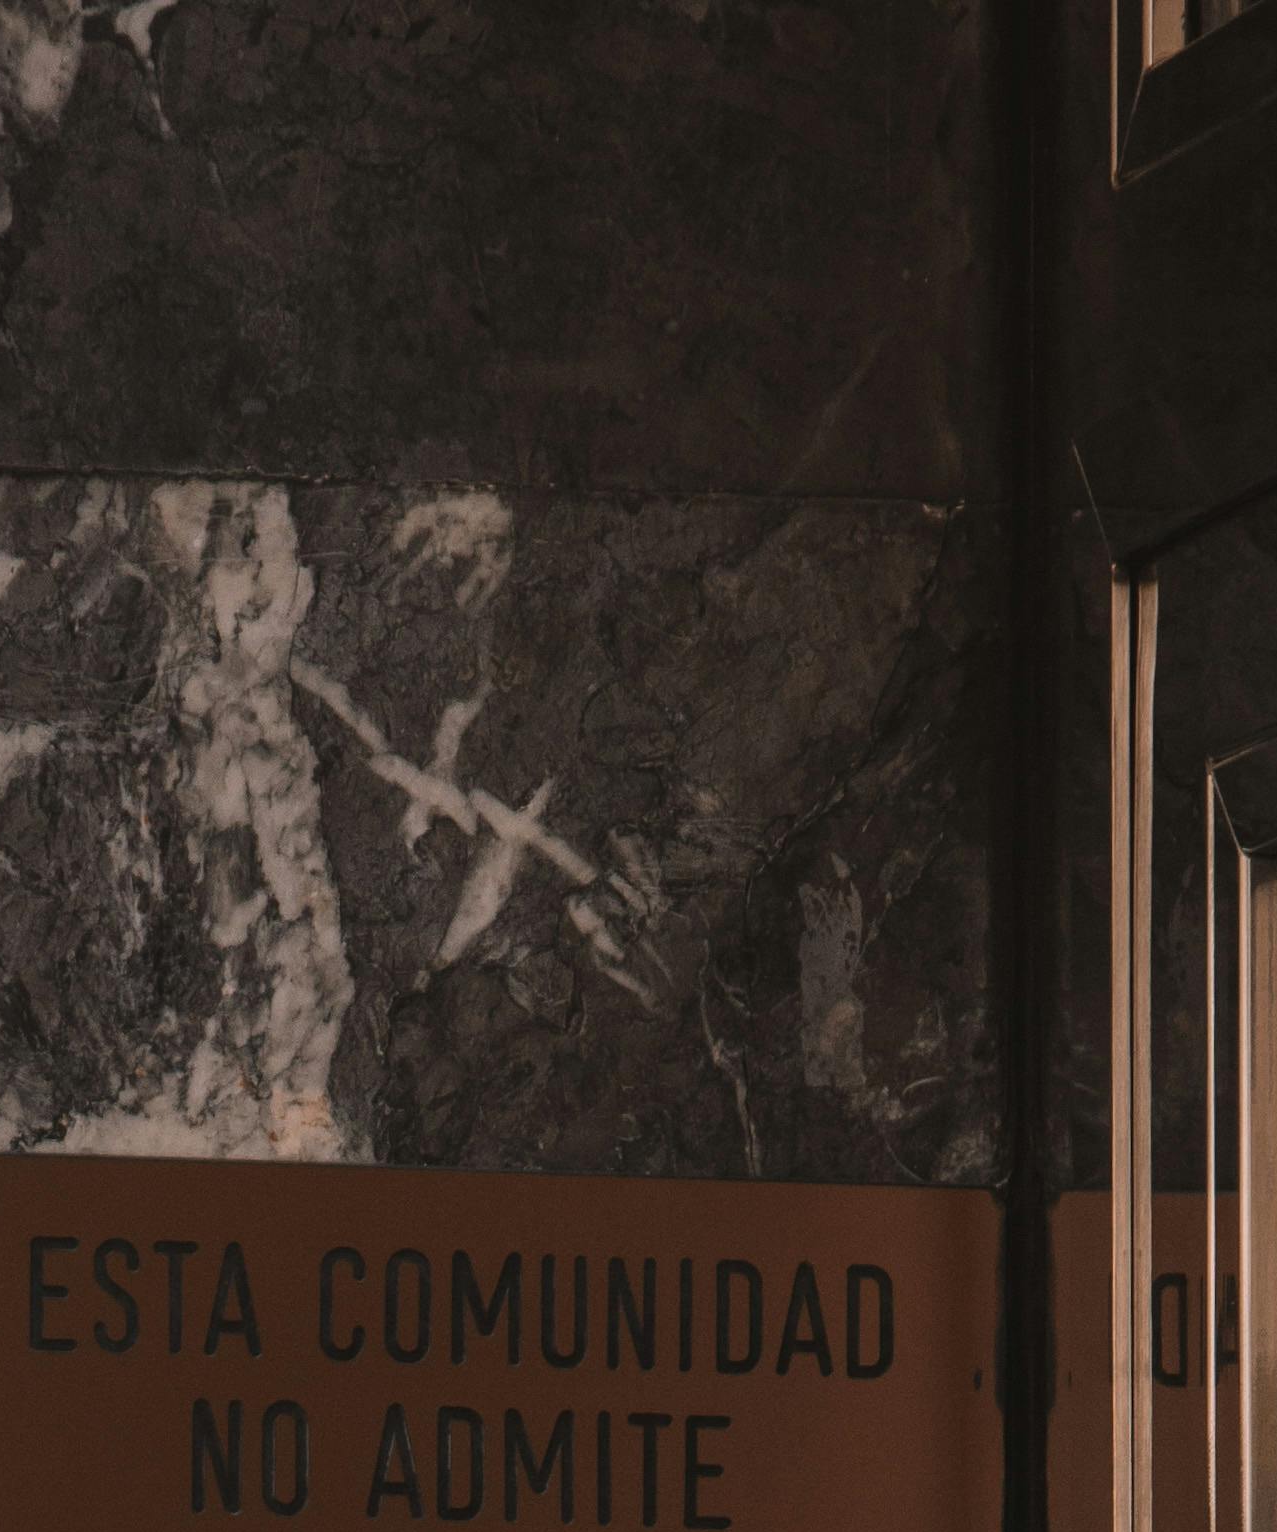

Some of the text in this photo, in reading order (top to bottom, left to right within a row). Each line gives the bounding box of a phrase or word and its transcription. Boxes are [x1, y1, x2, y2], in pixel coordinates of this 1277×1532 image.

[27, 1235, 895, 1379] ESTA COMUNIDAD
[190, 1398, 733, 1531] NO ADMITE
